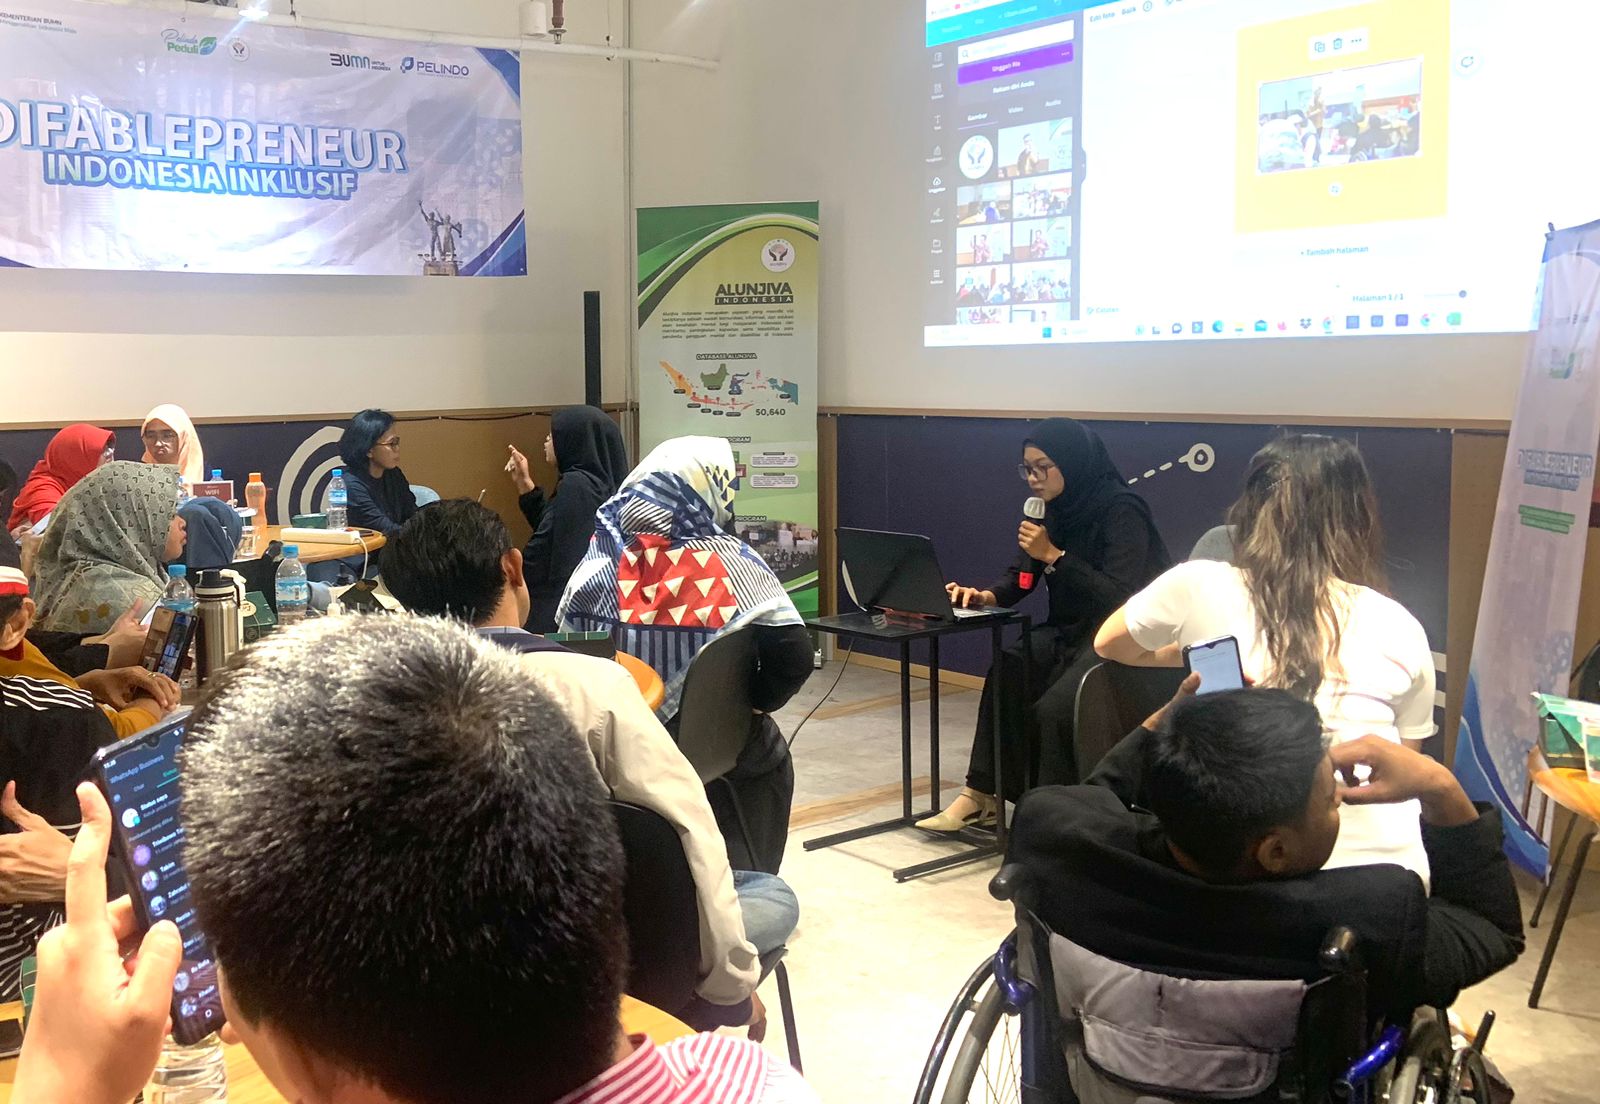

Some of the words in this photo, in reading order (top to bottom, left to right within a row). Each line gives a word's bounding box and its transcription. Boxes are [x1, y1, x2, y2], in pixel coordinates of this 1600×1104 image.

[167, 42, 199, 54] Peduli
[416, 61, 470, 76] PELINDO
[46, 152, 224, 191] INDONESIA
[226, 167, 356, 197] INKLUSIF
[715, 281, 793, 296] ALUNJIVA
[716, 296, 792, 304] INDONESIA
[727, 352, 758, 360] ALUNJIVA
[755, 408, 786, 417] 50,640
